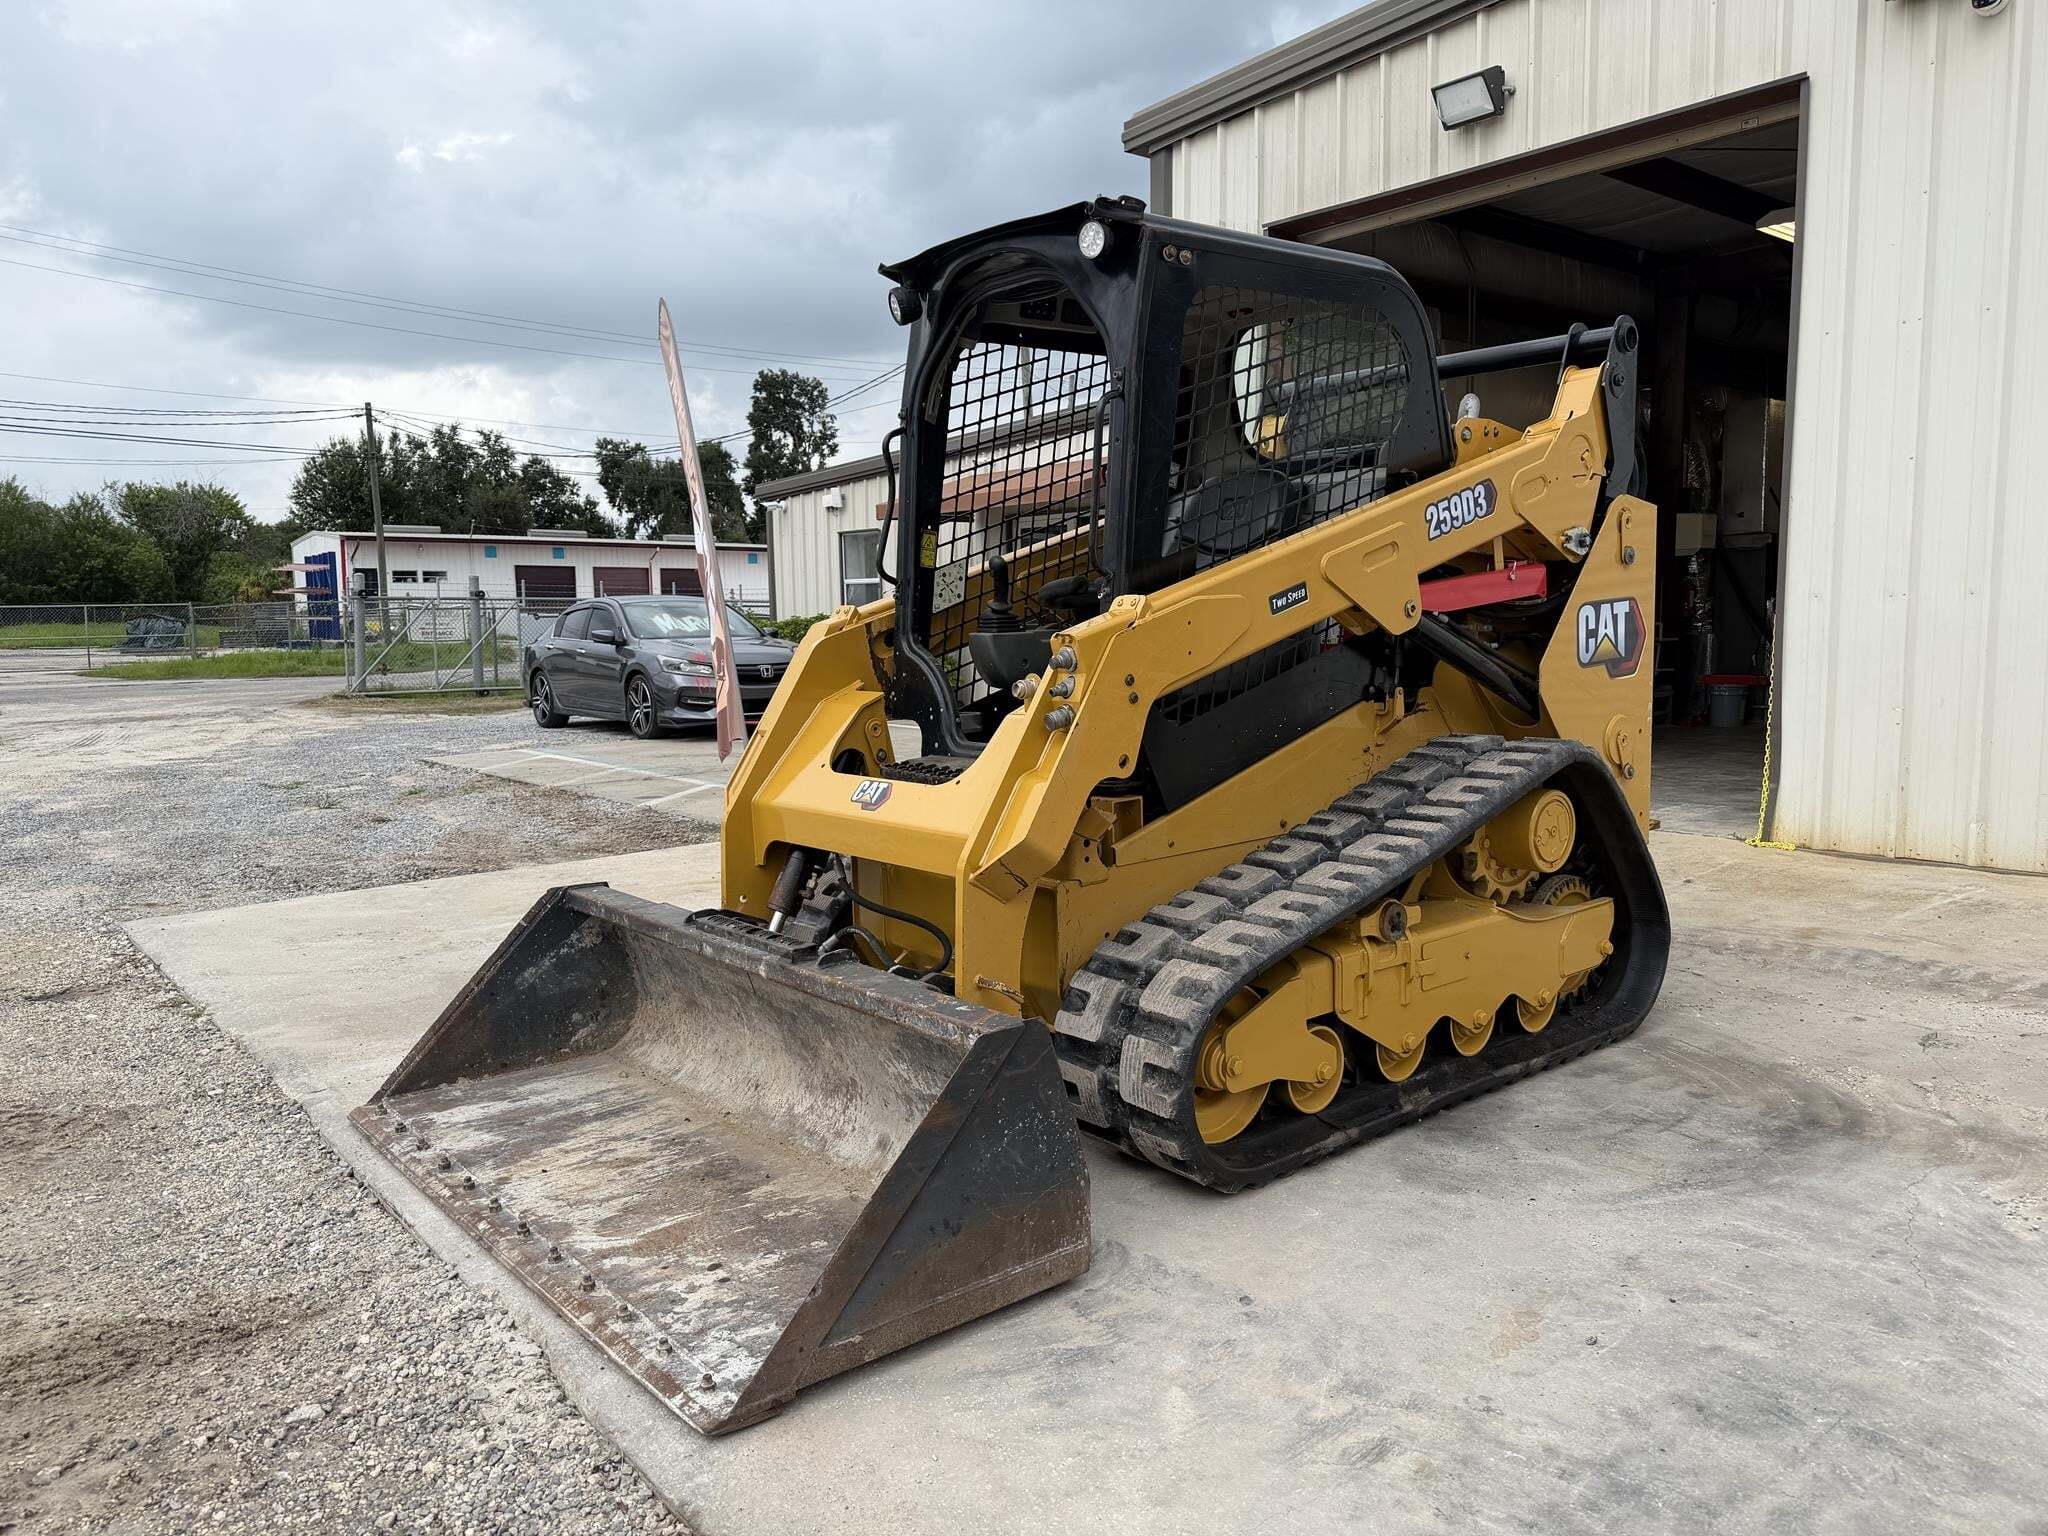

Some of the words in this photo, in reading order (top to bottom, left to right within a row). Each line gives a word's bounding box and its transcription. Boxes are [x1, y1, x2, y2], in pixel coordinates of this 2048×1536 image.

[1426, 484, 1487, 539] 259D3
[1578, 600, 1630, 664] CAT
[851, 780, 890, 804] CAT
